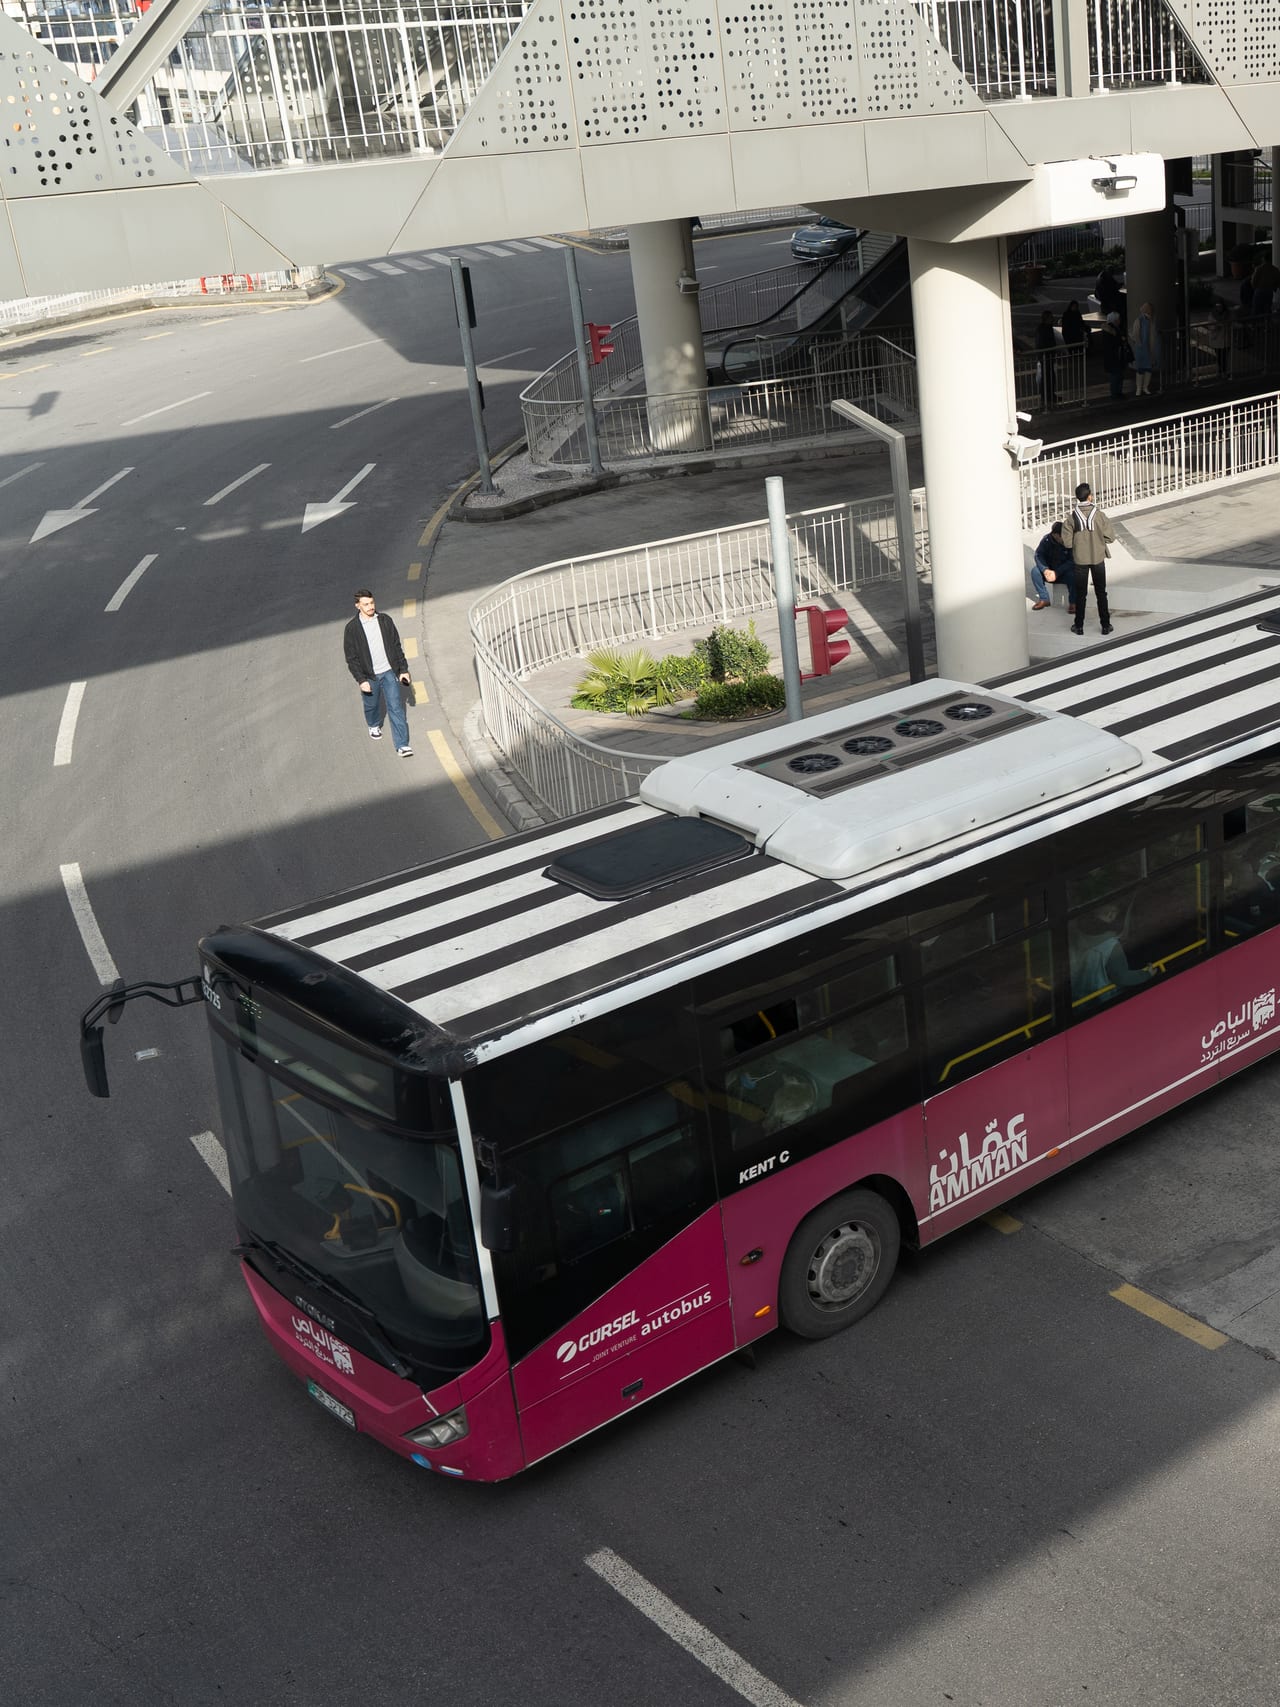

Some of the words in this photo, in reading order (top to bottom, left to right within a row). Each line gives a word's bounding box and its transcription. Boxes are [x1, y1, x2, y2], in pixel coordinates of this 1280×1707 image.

[1202, 1001, 1251, 1049] الباص
[739, 1158, 777, 1184] KENT
[779, 1150, 791, 1164] C
[929, 1135, 1028, 1212] AMMAN
[291, 1315, 331, 1351] الباص
[641, 1290, 712, 1337] autobus
[592, 1348, 609, 1363] JOINT
[610, 1334, 638, 1353] VENTURE
